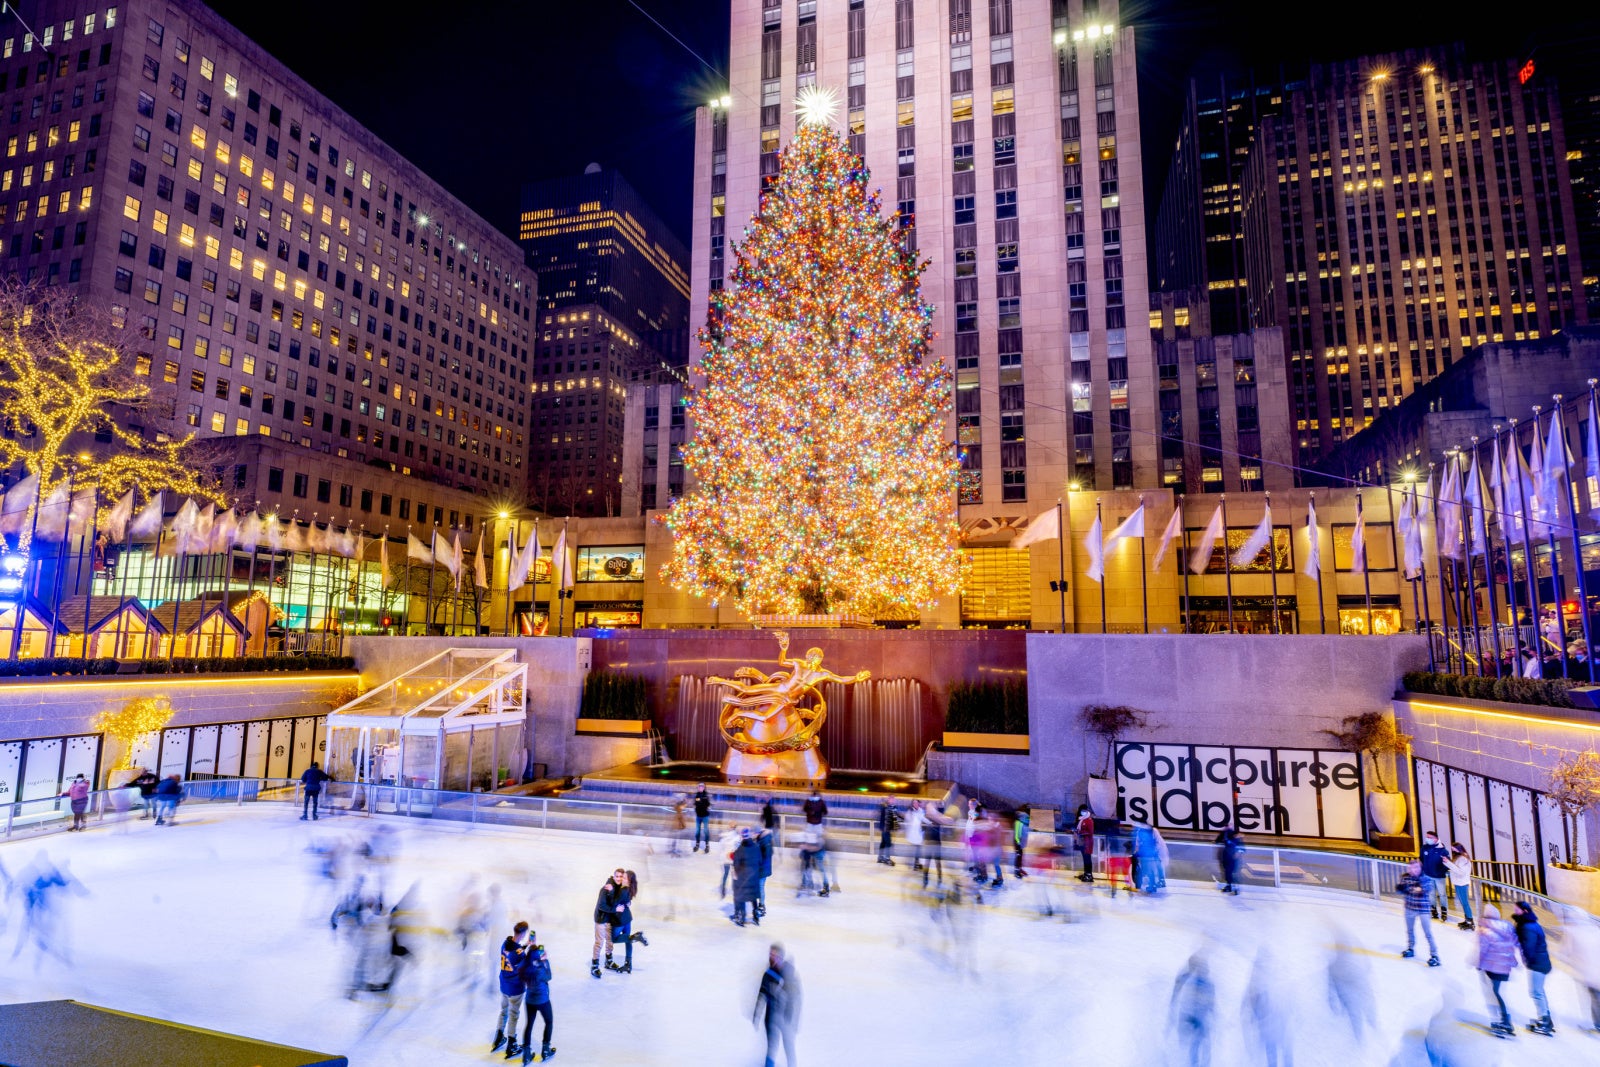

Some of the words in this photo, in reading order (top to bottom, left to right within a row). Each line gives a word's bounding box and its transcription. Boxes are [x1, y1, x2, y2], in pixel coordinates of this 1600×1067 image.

[608, 559, 628, 570] SING
[1117, 743, 1361, 790] Concourse
[1117, 786, 1149, 823] is
[1159, 788, 1290, 832] Open
